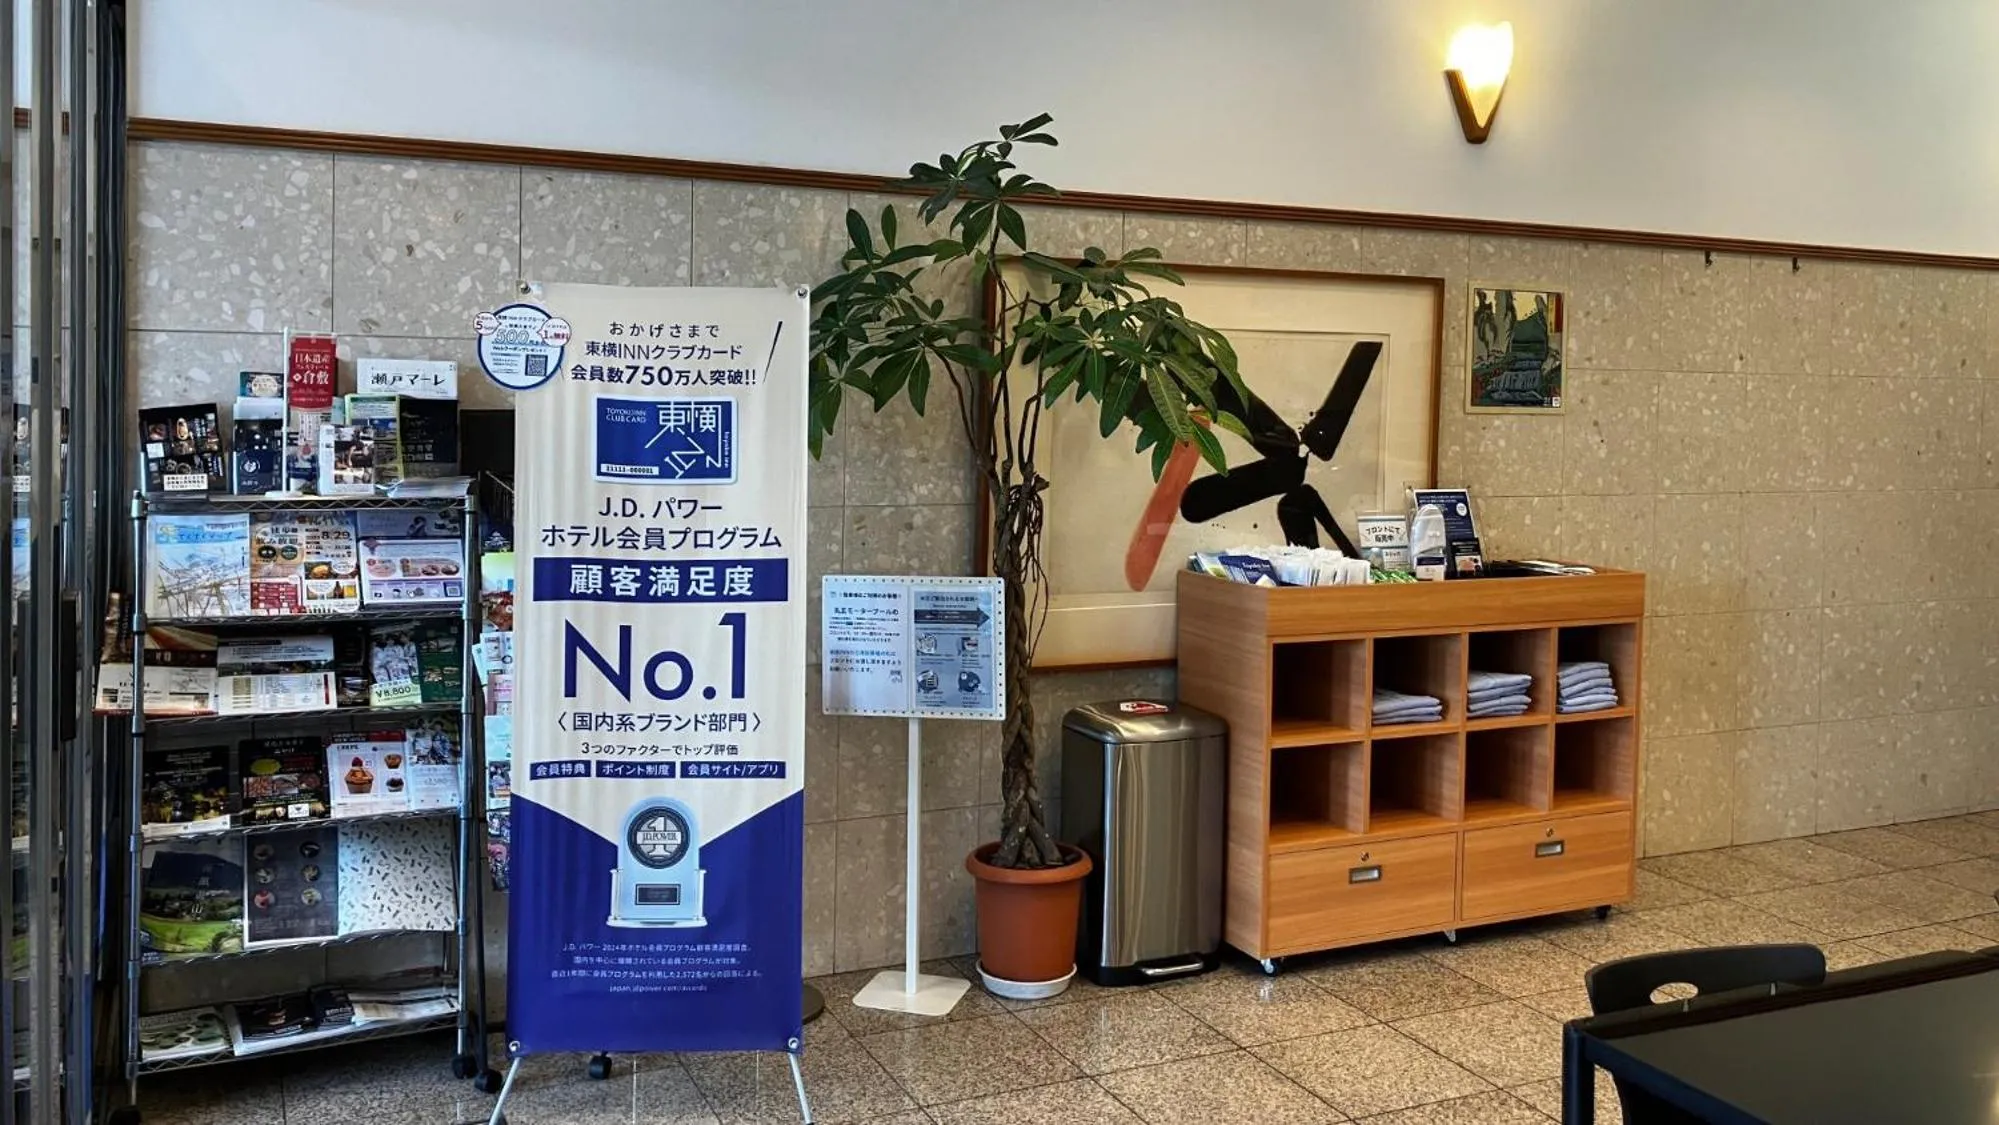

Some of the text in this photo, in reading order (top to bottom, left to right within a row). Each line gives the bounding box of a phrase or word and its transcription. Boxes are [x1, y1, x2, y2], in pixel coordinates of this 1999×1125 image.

[609, 322, 719, 337] おかげさまで
[585, 341, 741, 360] 東横INNクラブカード
[295, 352, 331, 364] 日本遺産
[371, 372, 446, 386] 瀬戸マーレ
[571, 364, 756, 387] 会員数750万人突破!!
[606, 414, 646, 423] CLUB CARD
[598, 497, 722, 518] J.D. パワー
[1365, 526, 1401, 535] フロントにて
[541, 526, 782, 550] ホテル会員プログラム
[569, 564, 754, 597] 顧客満足度
[564, 612, 747, 703] No.1
[581, 742, 739, 756] 3つのファクターでトップ評価
[536, 763, 586, 776] 会員特典
[602, 764, 670, 776] ポイント制度
[687, 764, 779, 776] 会員サイト/アプリ
